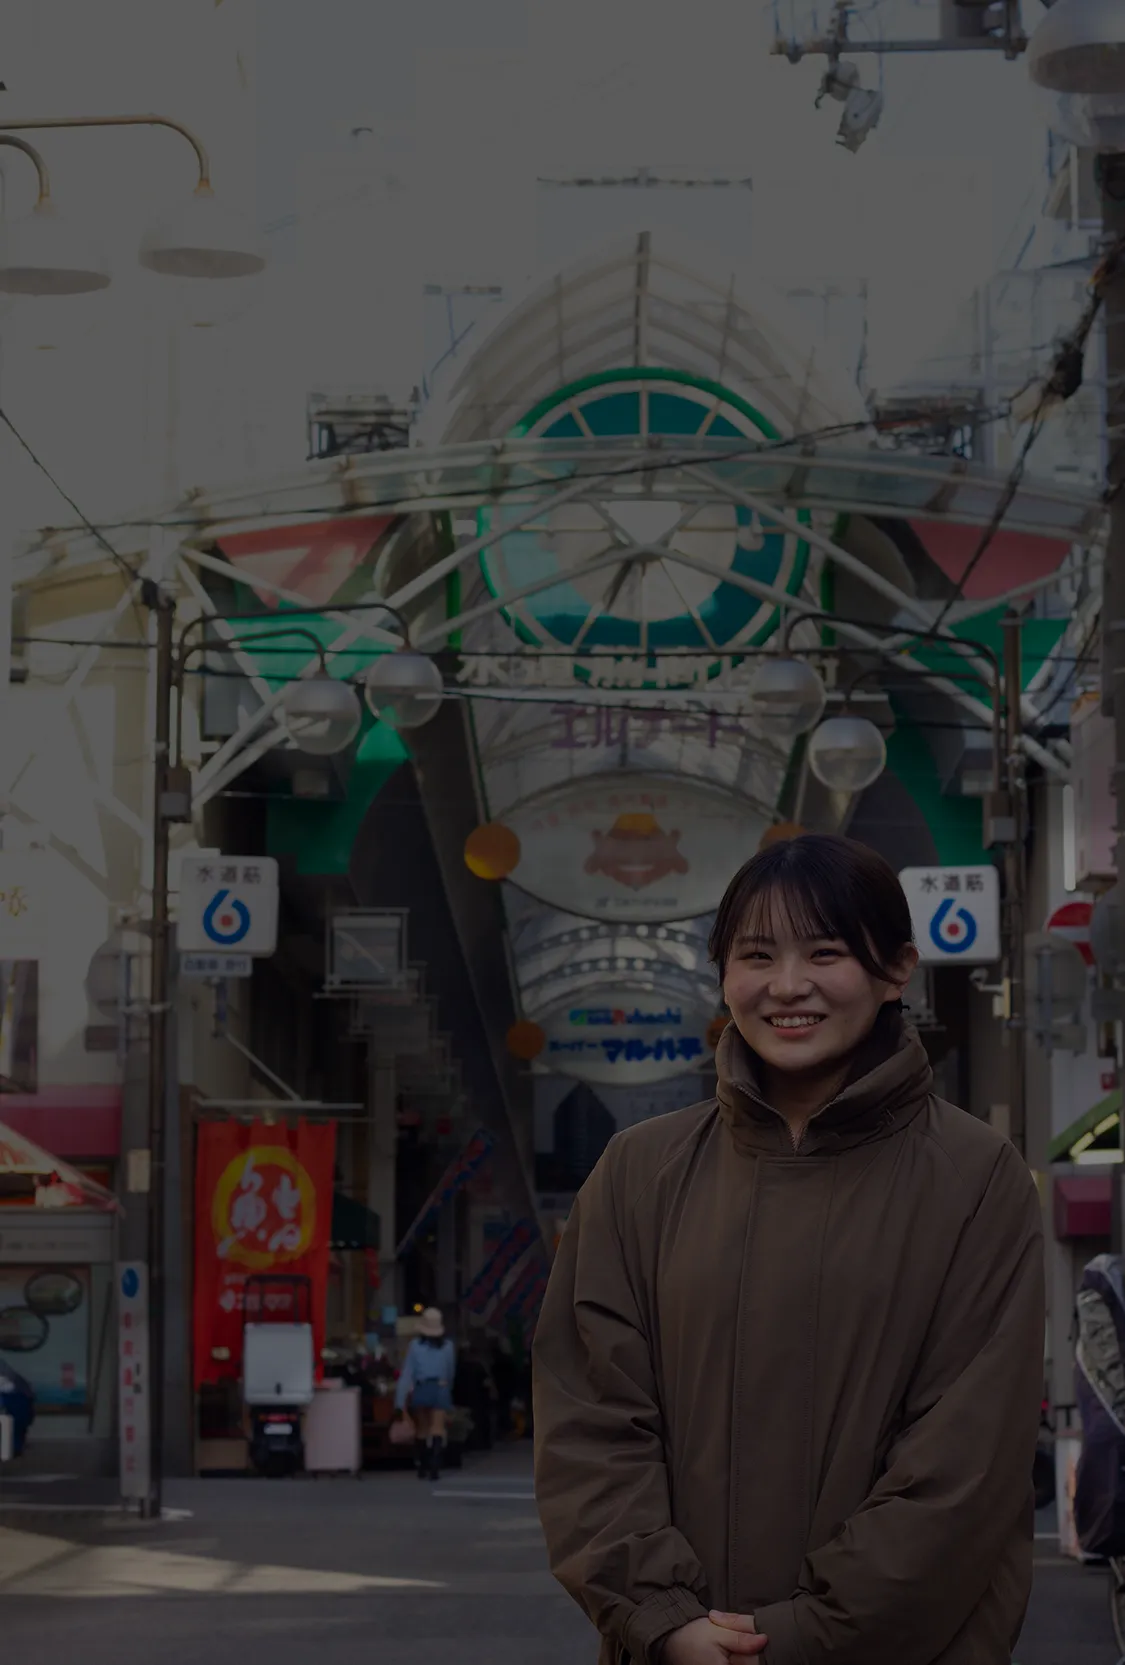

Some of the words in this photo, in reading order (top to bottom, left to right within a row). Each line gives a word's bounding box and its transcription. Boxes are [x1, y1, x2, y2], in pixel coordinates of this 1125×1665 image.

[196, 864, 262, 884] 水道筋
[919, 873, 984, 893] 水道筋
